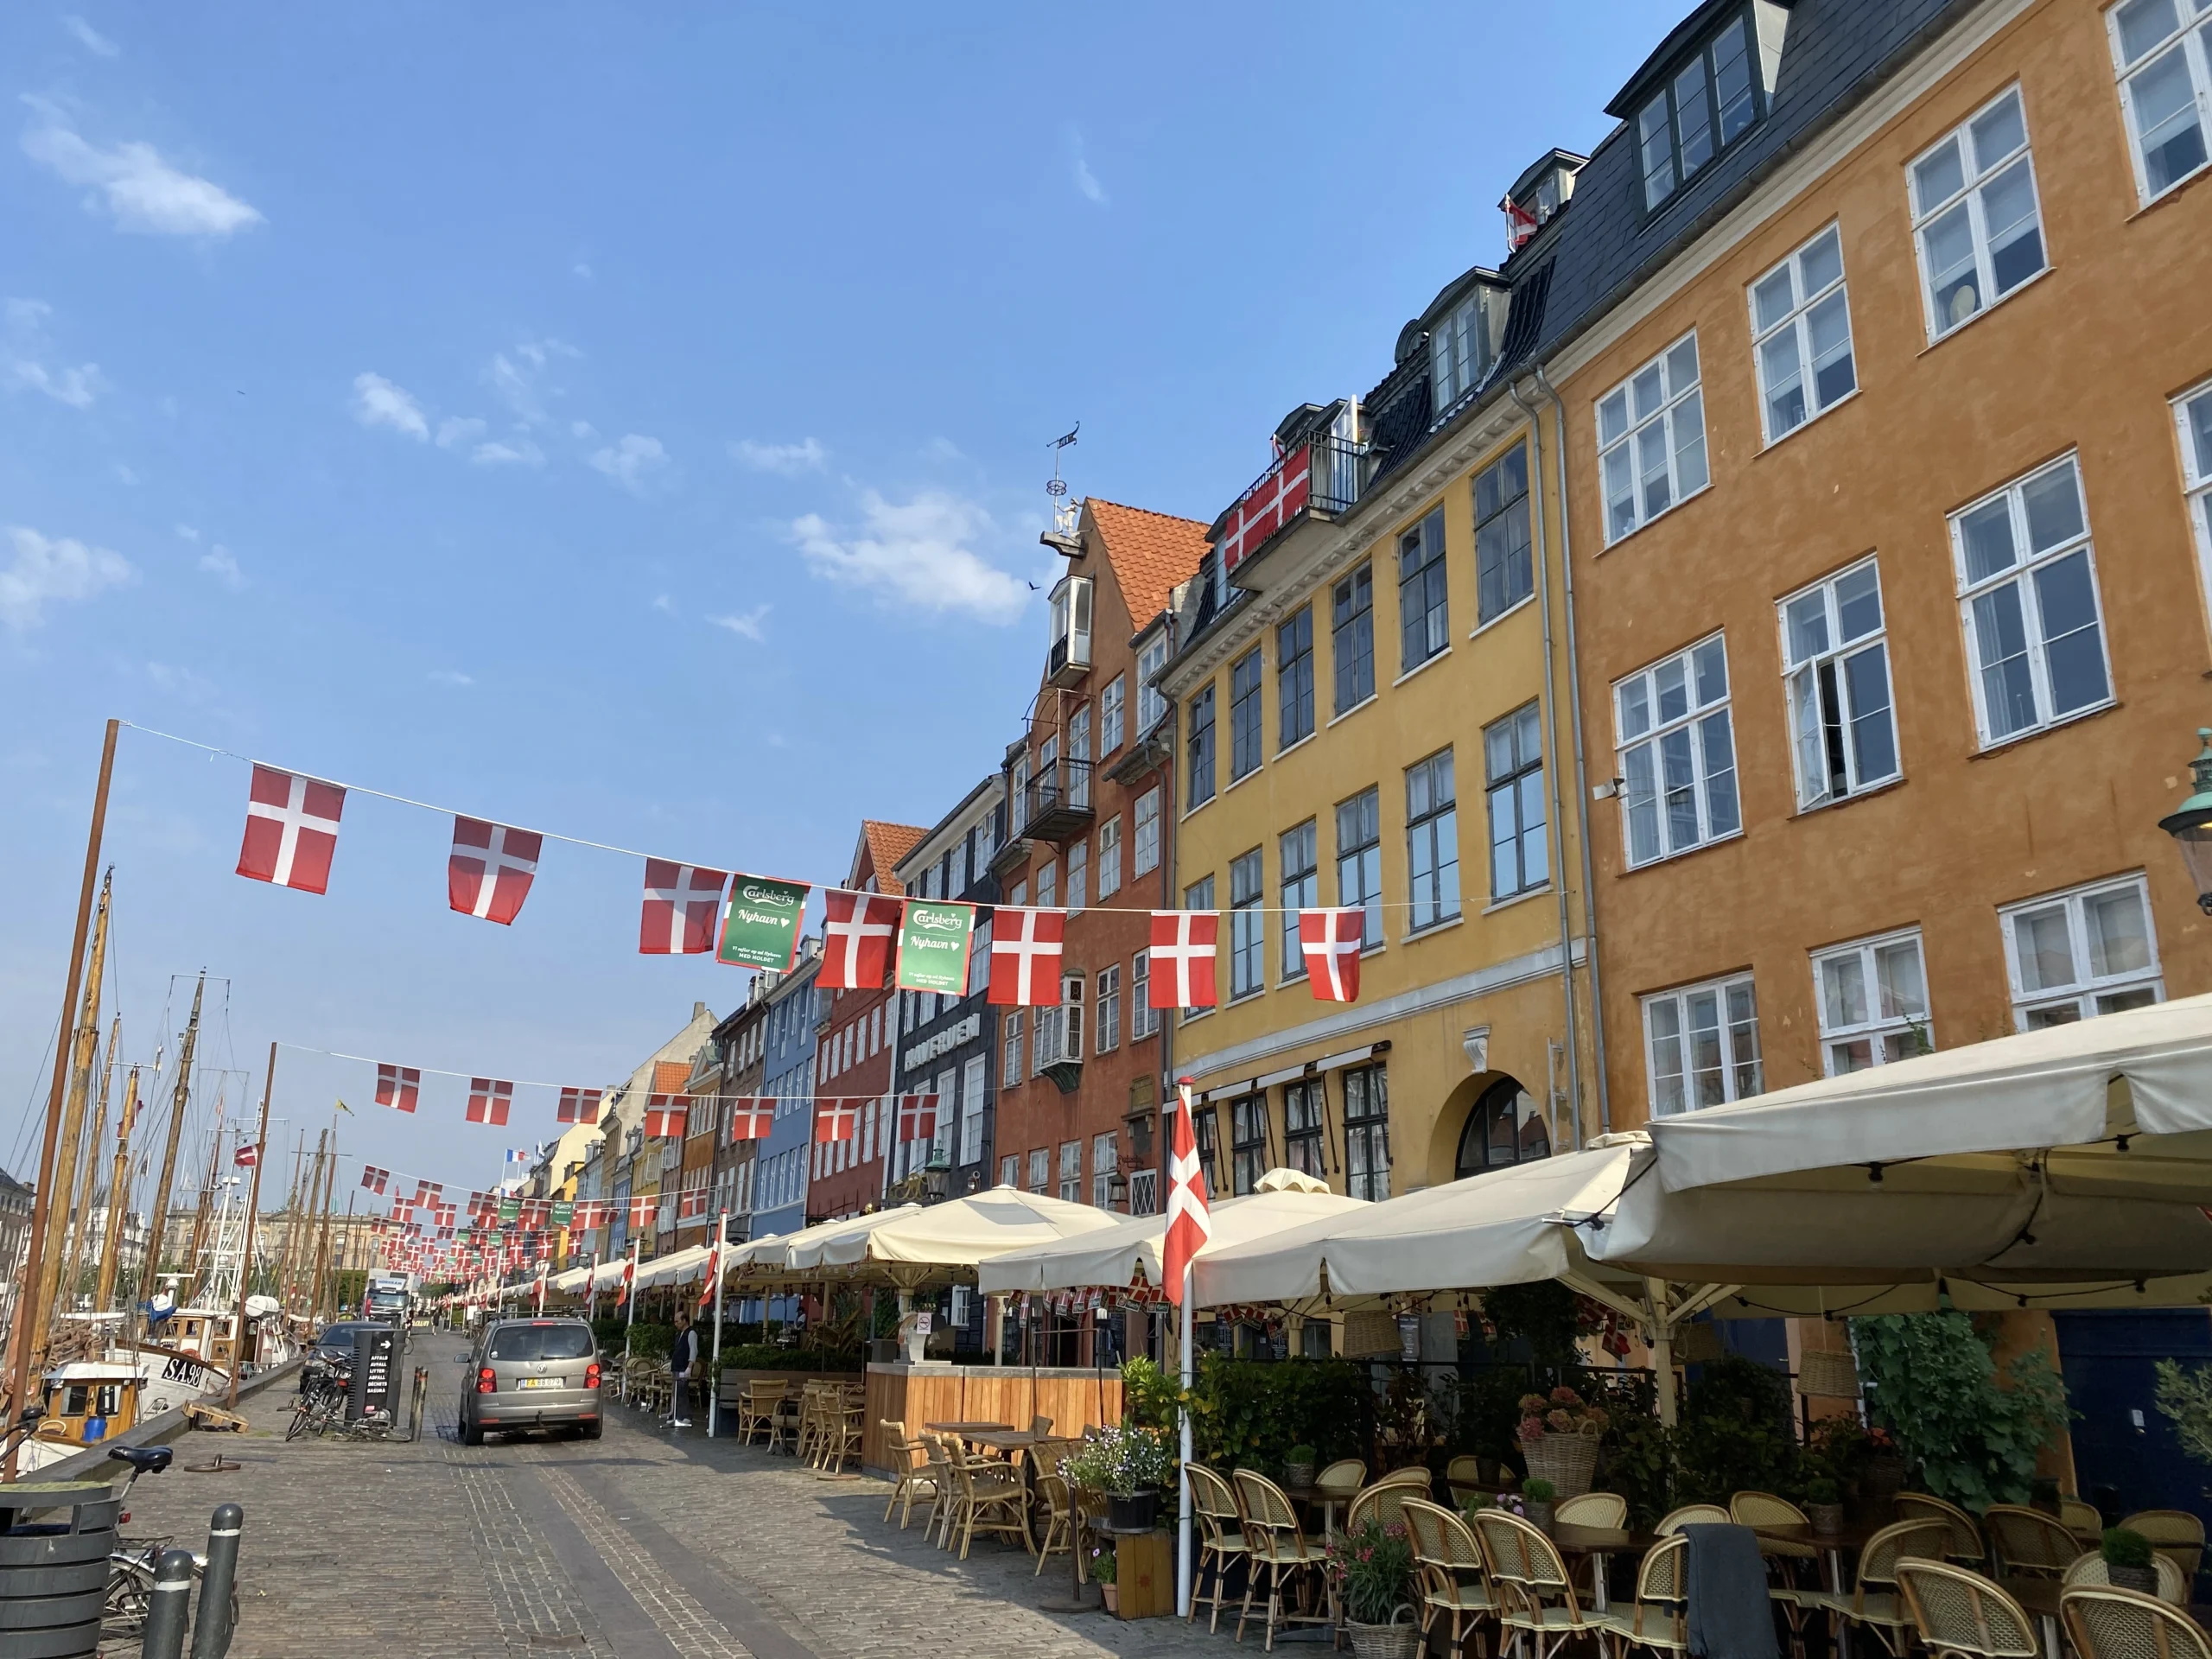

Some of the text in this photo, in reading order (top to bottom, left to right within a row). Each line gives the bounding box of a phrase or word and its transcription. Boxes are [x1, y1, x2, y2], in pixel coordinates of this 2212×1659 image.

[743, 885, 795, 906] Carlsberg
[738, 909, 778, 925] Nyhavn
[913, 910, 963, 931] Carlsberg
[911, 936, 949, 950] Nyhavn
[904, 1013, 980, 1072] RAVFRUEN
[164, 1358, 202, 1386] S.A.98
